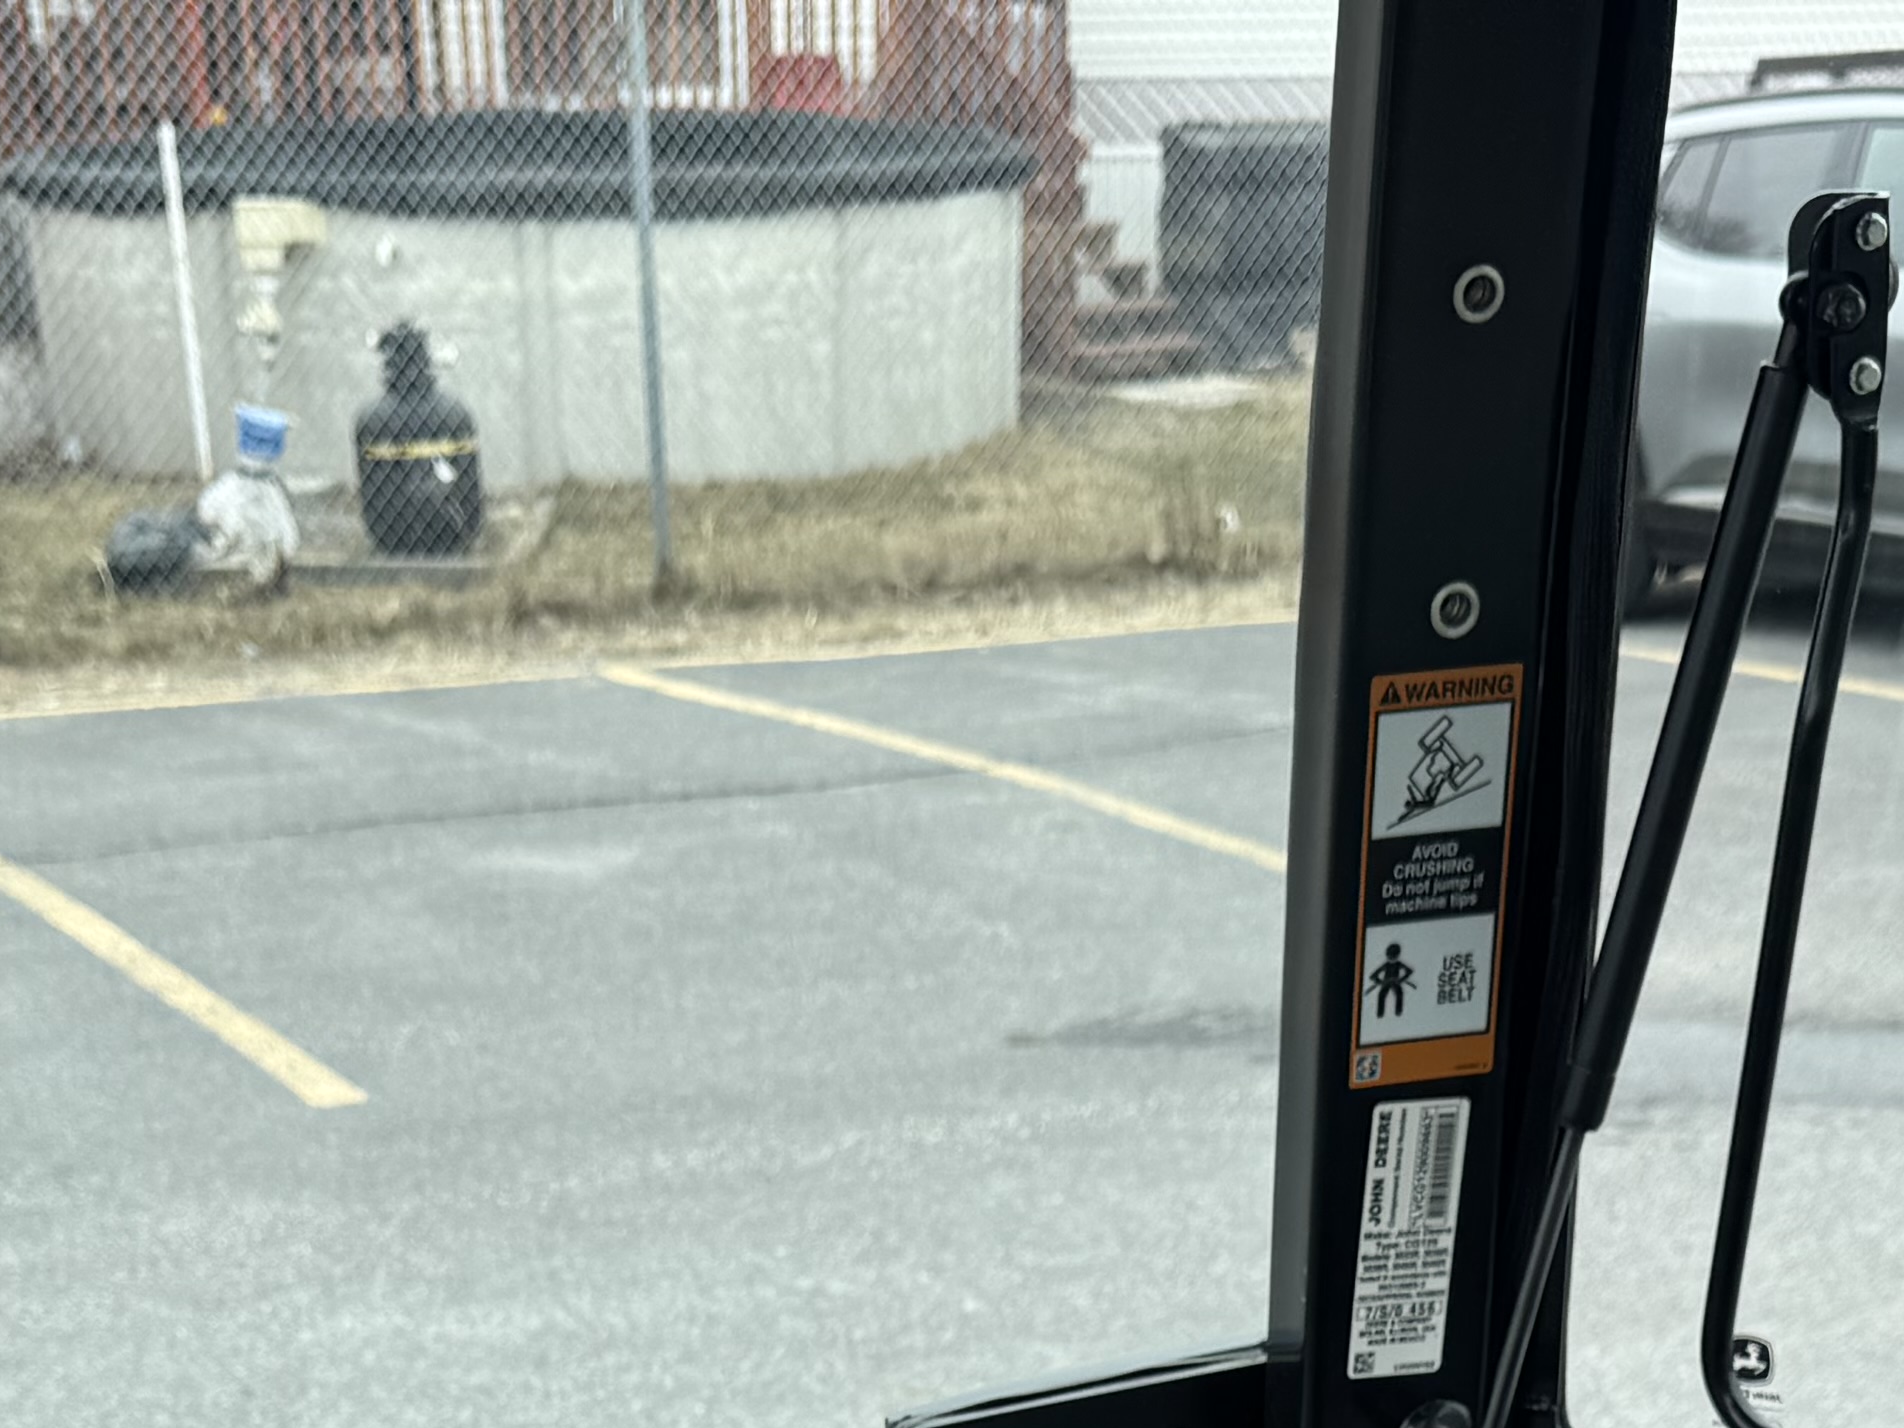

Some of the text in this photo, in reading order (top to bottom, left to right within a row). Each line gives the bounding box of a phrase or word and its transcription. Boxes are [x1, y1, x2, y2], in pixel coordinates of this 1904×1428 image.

[1404, 673, 1515, 701] WARNING
[1412, 841, 1459, 861] AVOID
[1393, 857, 1474, 879] CRUSHING
[1381, 871, 1485, 898] Do not jump if
[1385, 892, 1478, 915] machine tips
[1442, 953, 1474, 971] USE
[1437, 970, 1476, 988] SEAT
[1437, 987, 1475, 1005] BELT
[1368, 1110, 1393, 1227] JOHN DEERE
